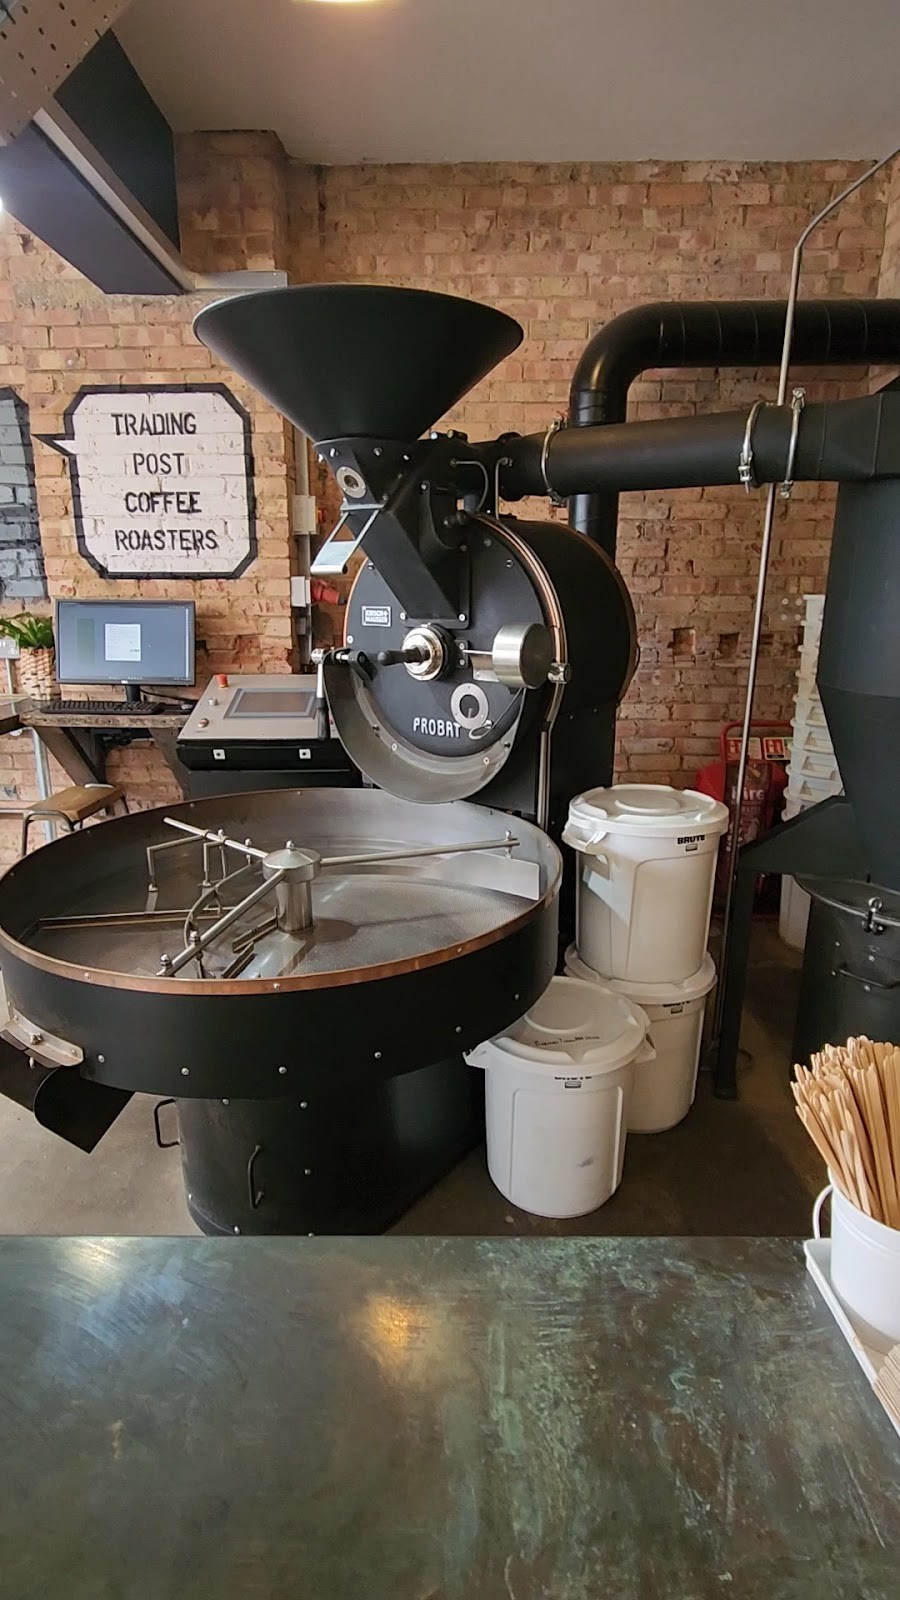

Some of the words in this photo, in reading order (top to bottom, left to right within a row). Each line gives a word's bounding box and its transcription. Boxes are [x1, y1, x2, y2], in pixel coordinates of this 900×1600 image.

[111, 412, 197, 436] TRADING
[133, 453, 185, 475] POST
[124, 491, 202, 513] COFFEE
[114, 529, 219, 551] ROASTERS
[413, 717, 461, 738] PROBAT
[677, 834, 706, 845] BRUTE
